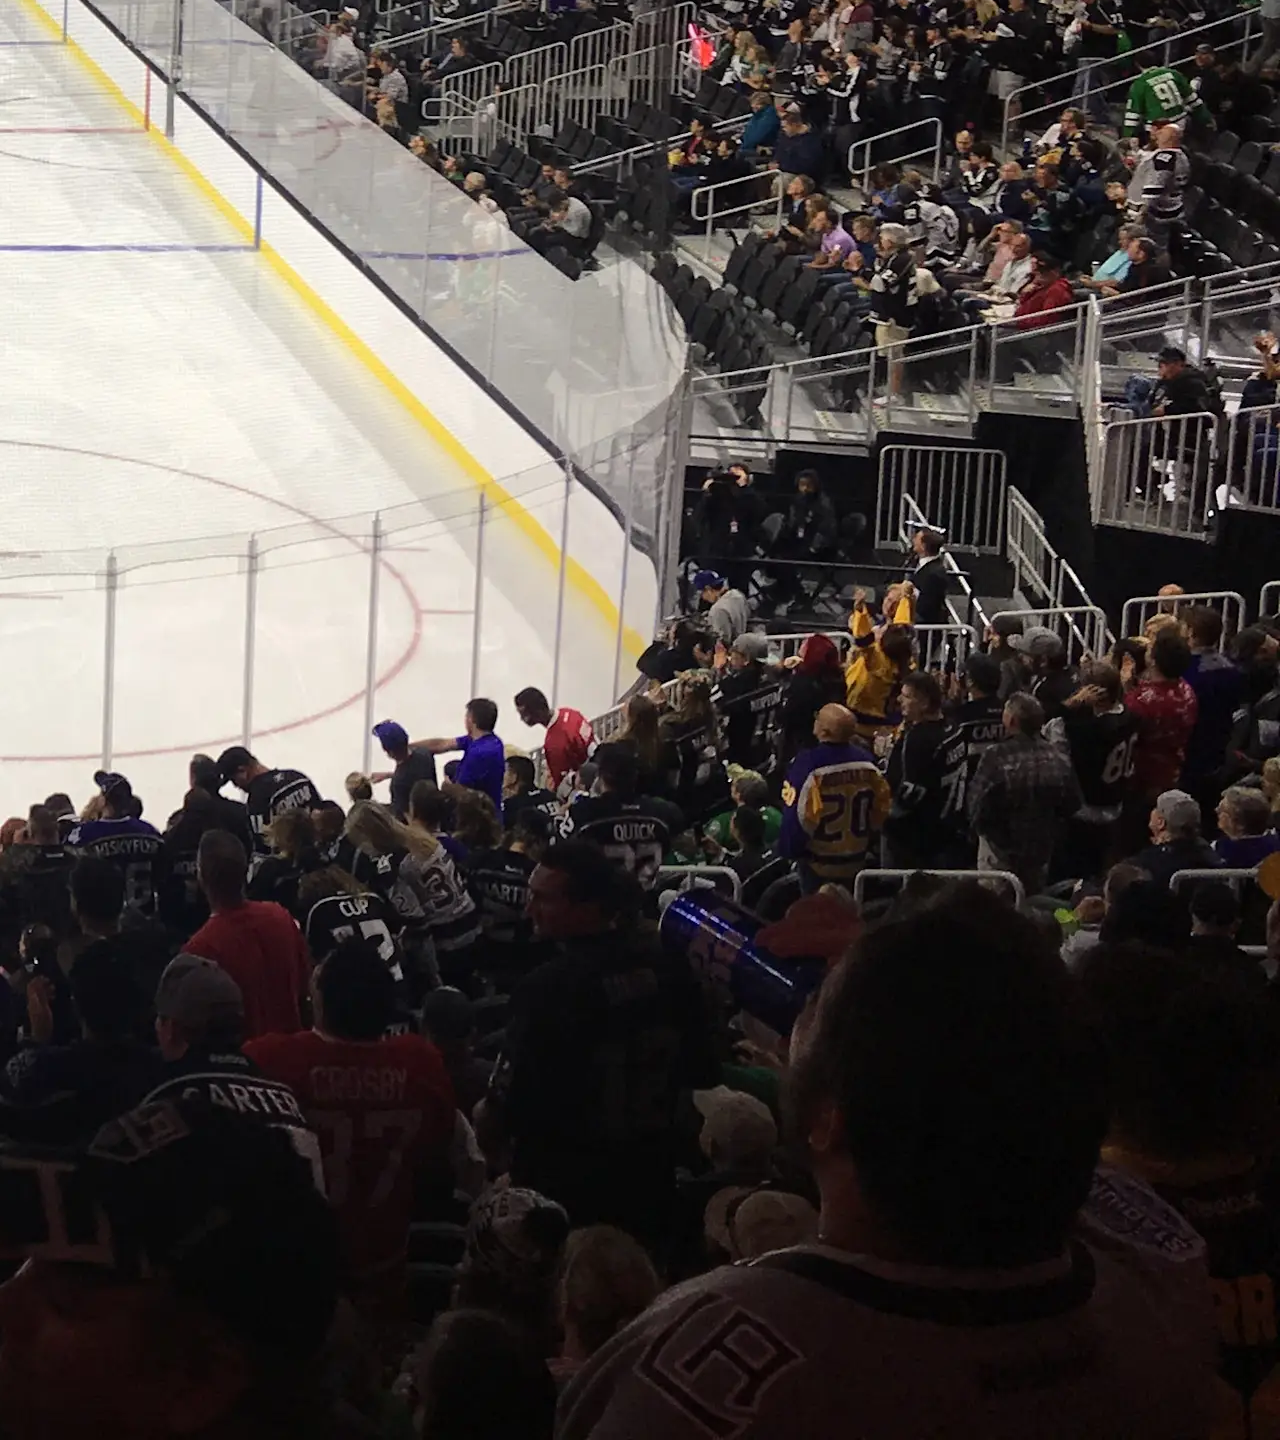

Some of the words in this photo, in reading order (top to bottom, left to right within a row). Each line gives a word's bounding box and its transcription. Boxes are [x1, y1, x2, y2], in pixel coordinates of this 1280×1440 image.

[1153, 80, 1183, 110] 91
[973, 723, 1007, 740] CART
[613, 823, 656, 842] QUICK
[338, 897, 369, 918] CUP
[310, 1066, 407, 1101] CROSBY
